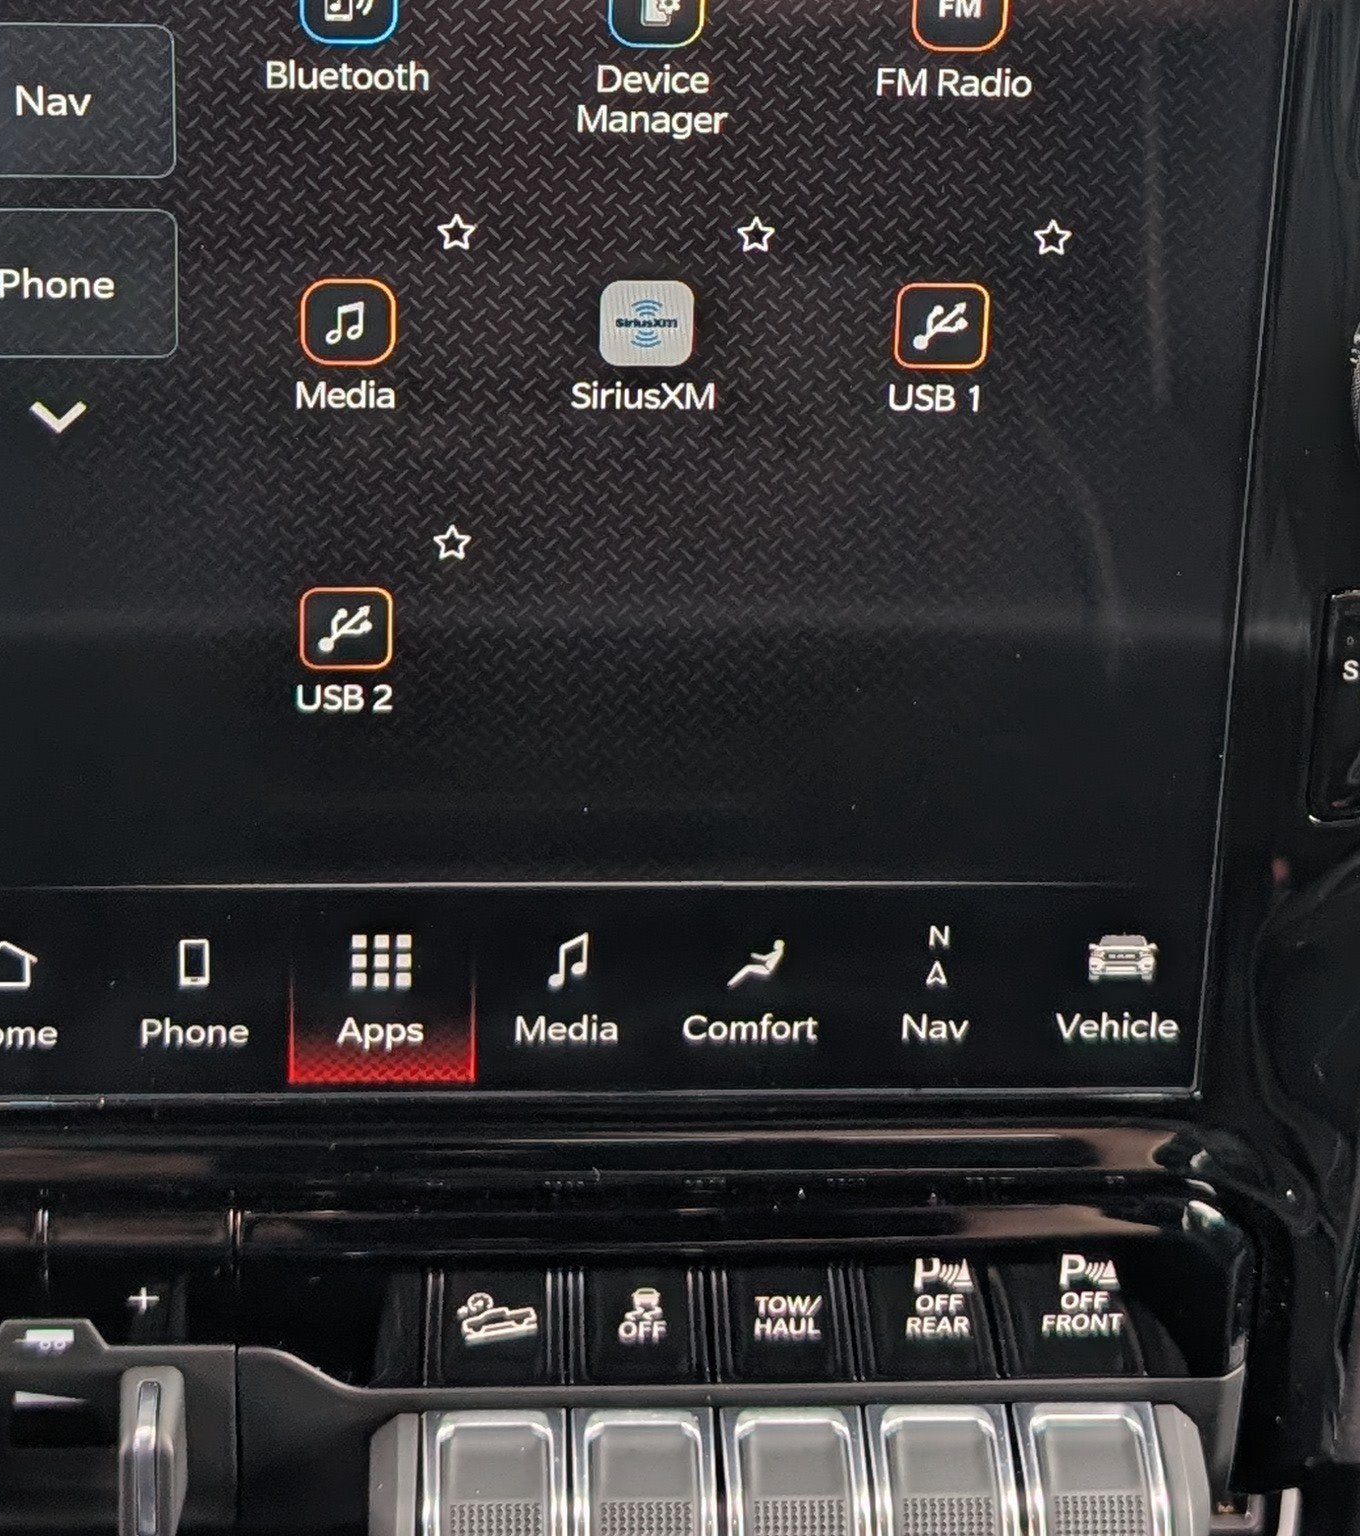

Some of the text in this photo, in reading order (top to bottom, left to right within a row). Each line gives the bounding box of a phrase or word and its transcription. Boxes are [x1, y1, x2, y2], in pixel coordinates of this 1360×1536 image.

[266, 59, 429, 92] Bluetooth
[597, 63, 710, 94] Device
[876, 67, 1032, 98] FM Radio
[15, 84, 92, 117] Nav
[577, 104, 729, 140] Manager
[296, 379, 396, 410] Media
[570, 380, 715, 410] SiriusXM
[888, 383, 980, 413] USB 1
[296, 683, 393, 712] USB 2
[928, 925, 950, 947] N
[141, 1017, 249, 1047] Phone
[336, 1016, 424, 1052] Apps
[515, 1014, 618, 1043] Media
[682, 1012, 818, 1041] Comfort
[901, 1013, 969, 1040] Nav
[1056, 1011, 1179, 1040] Vehicle
[754, 1295, 822, 1317] TOW/
[915, 1293, 964, 1314] OFF
[1060, 1291, 1109, 1312] OFF
[618, 1321, 667, 1346] OFF
[754, 1316, 821, 1338] HAUL
[906, 1315, 970, 1338] REAR
[1041, 1313, 1124, 1333] FRONT
